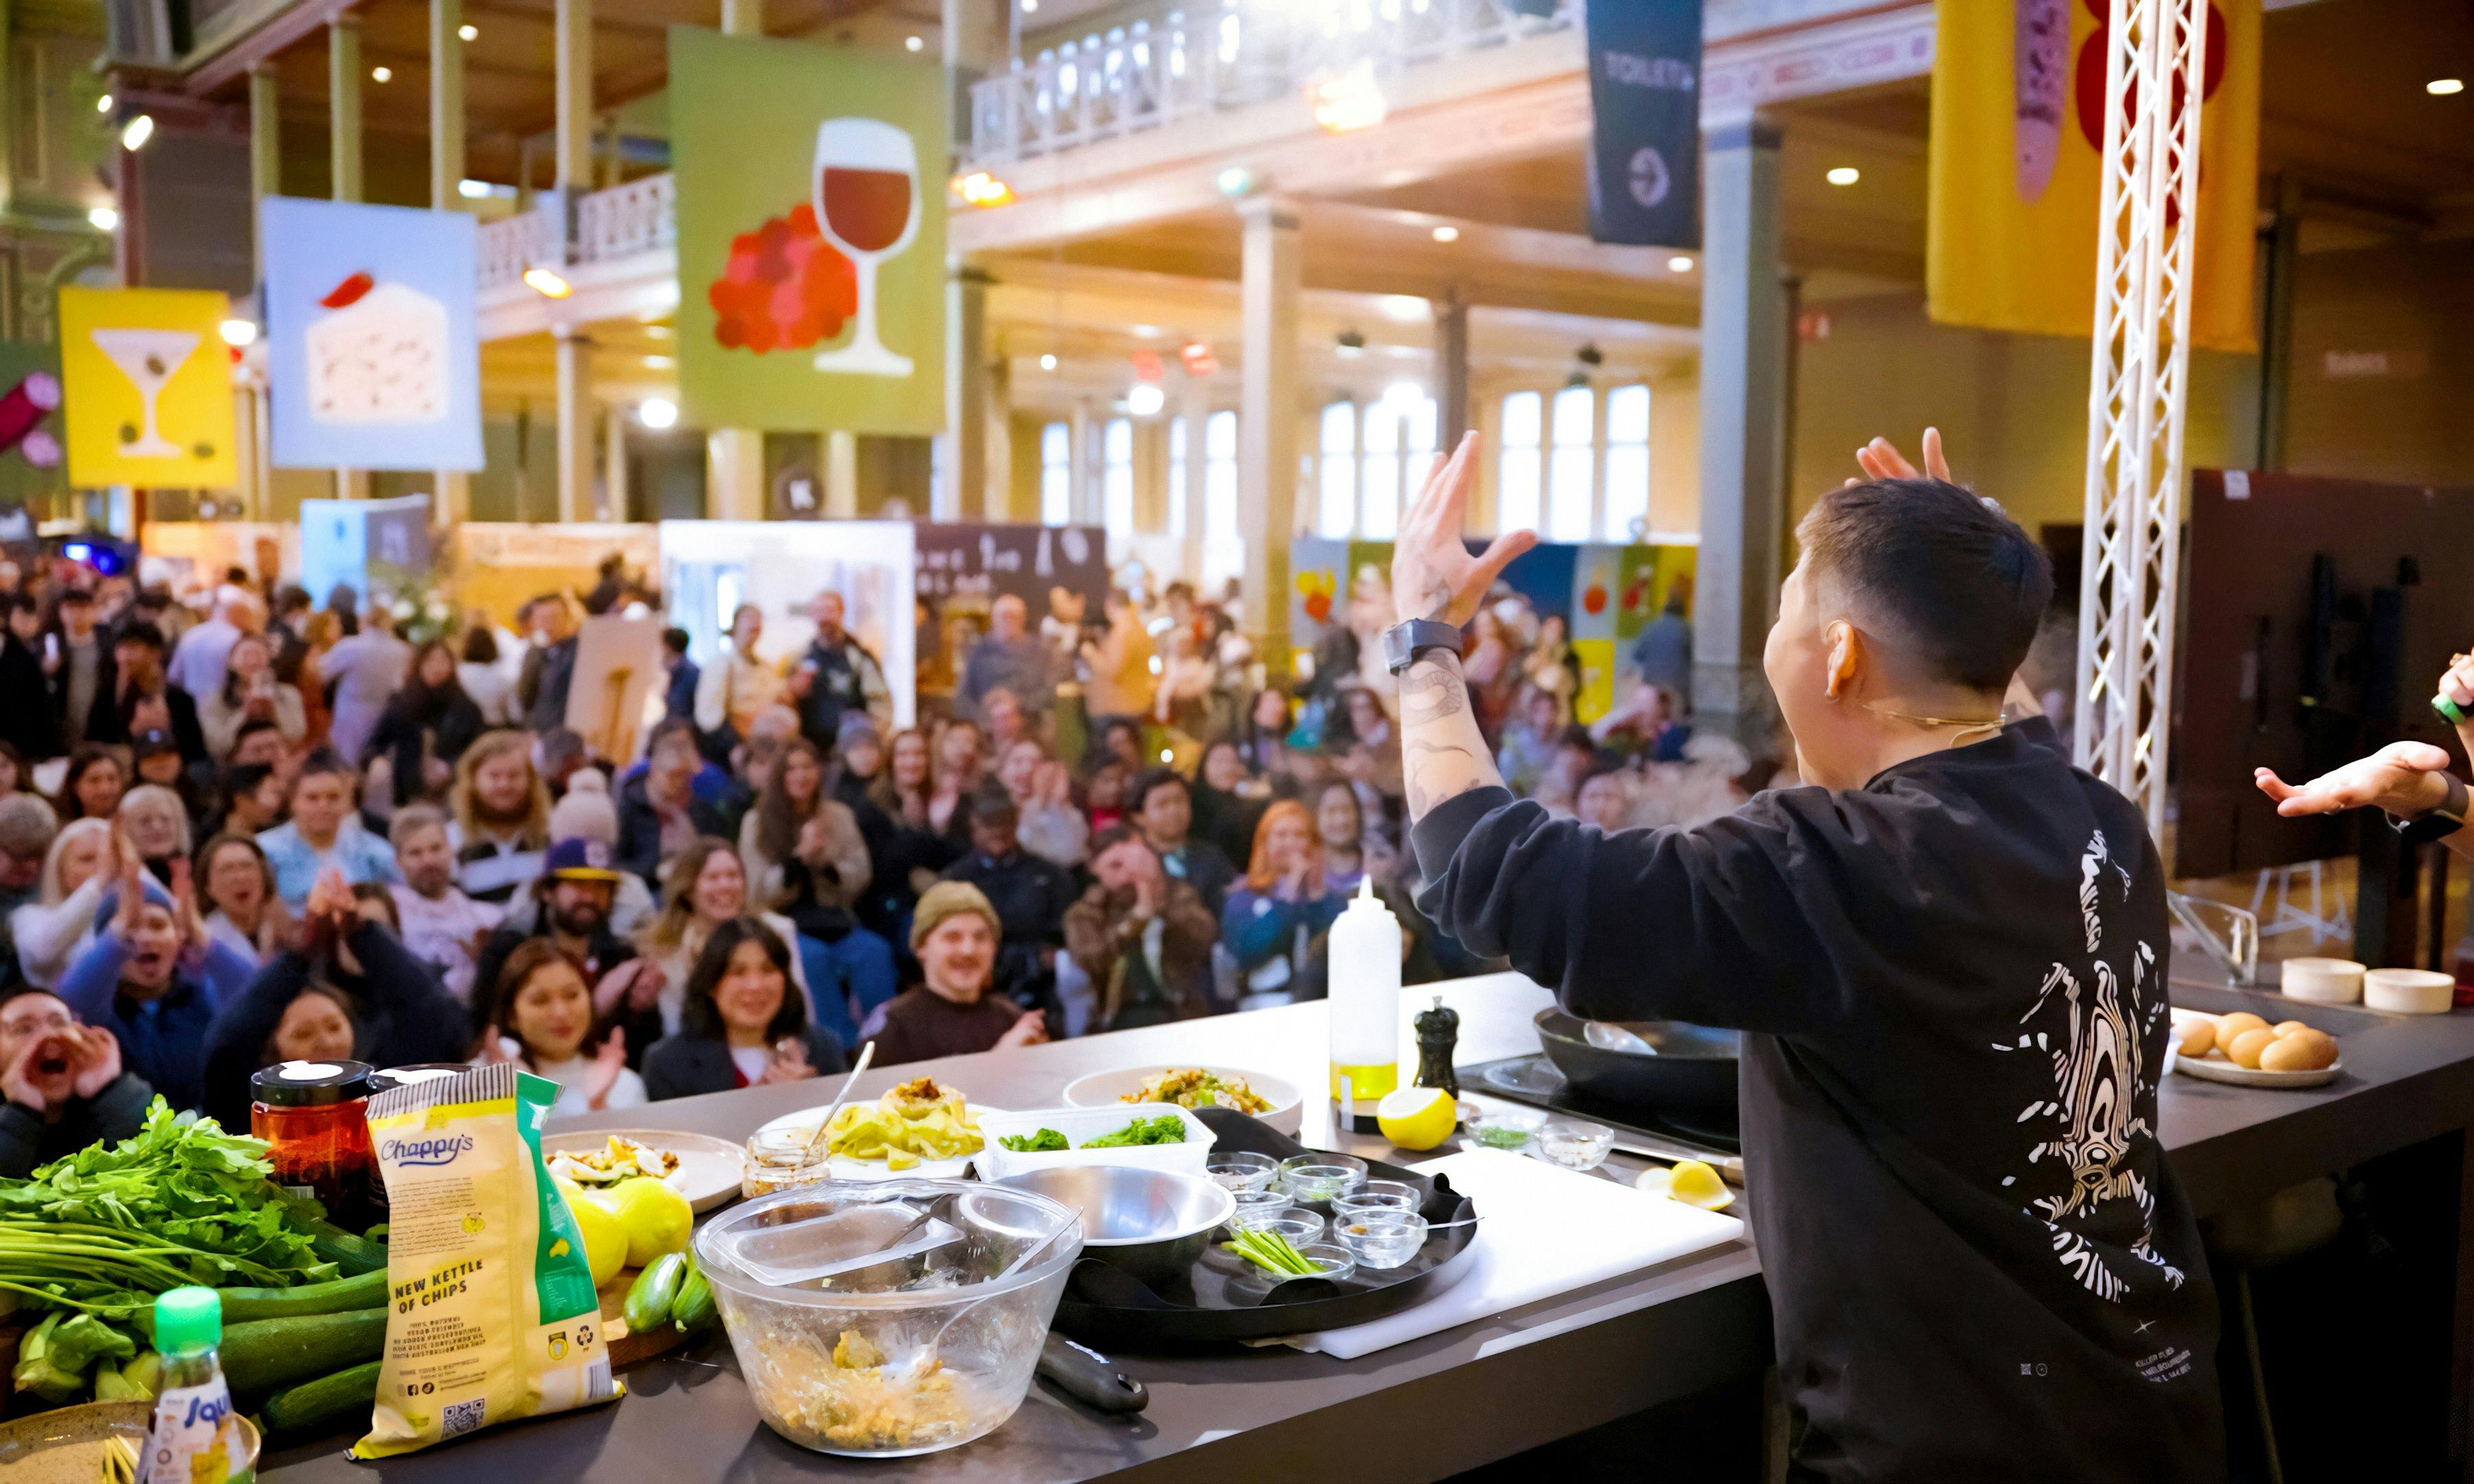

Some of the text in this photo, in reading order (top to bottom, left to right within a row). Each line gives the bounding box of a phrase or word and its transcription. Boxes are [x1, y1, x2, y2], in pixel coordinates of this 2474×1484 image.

[381, 1134, 473, 1167] Chappy's
[395, 1259, 483, 1298] NEW KETTLE
[399, 1280, 467, 1314] OF CHIPS
